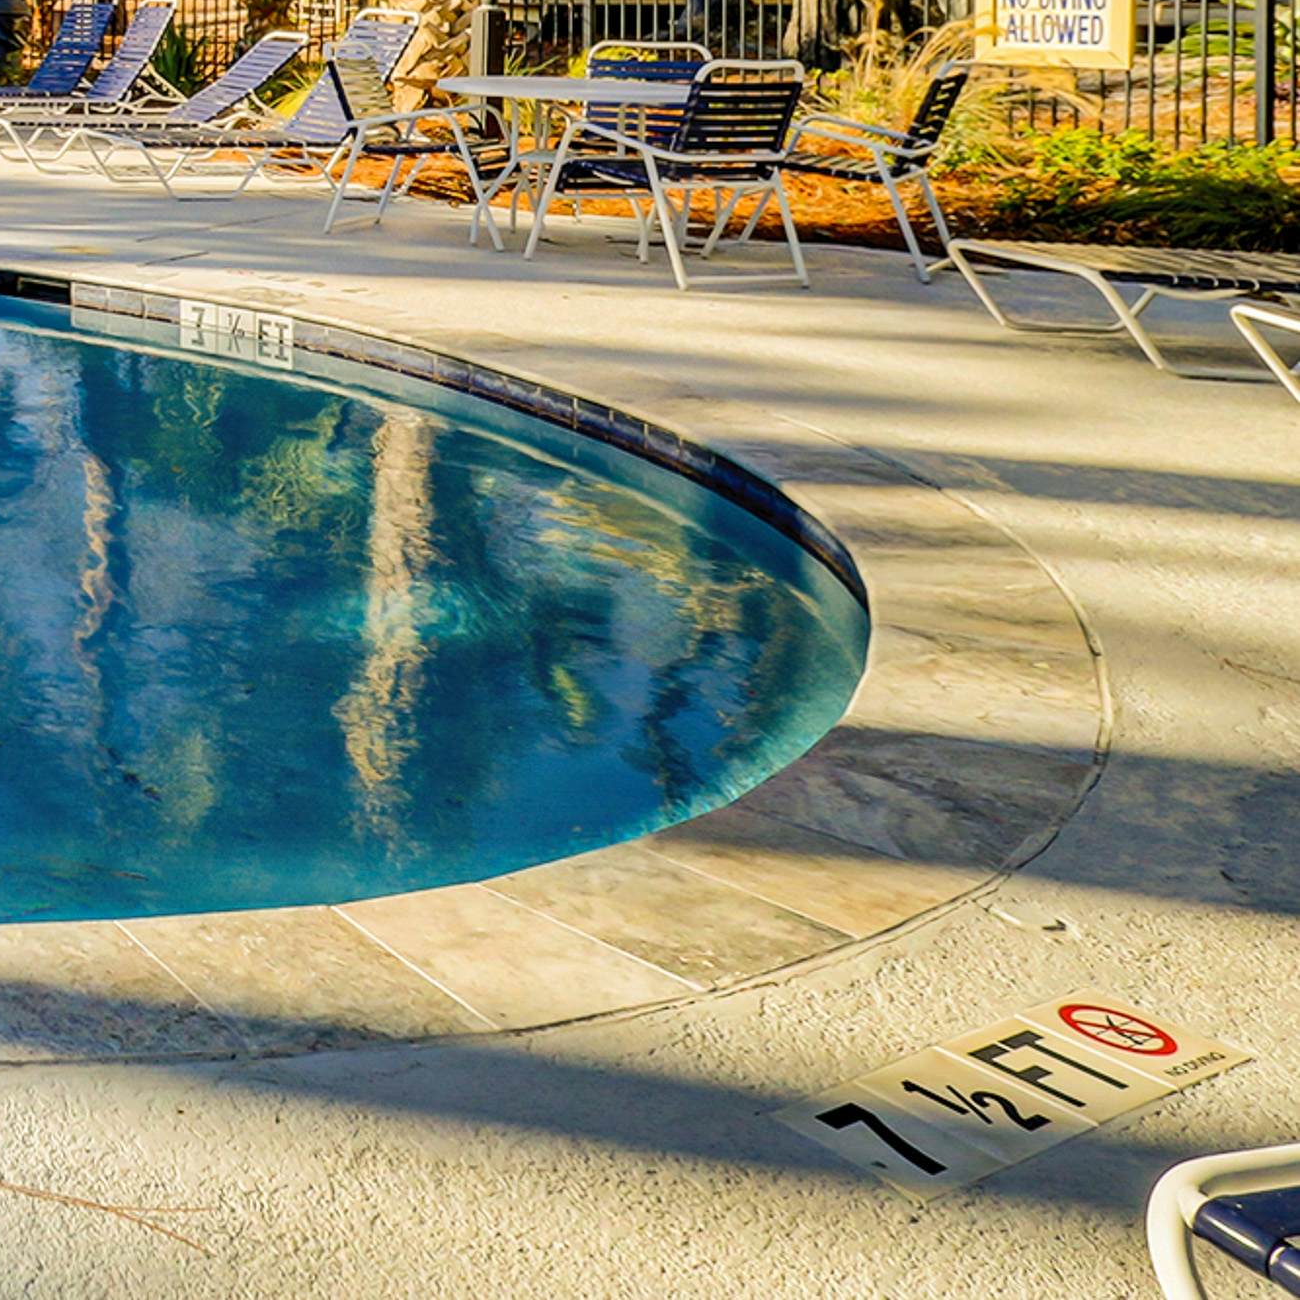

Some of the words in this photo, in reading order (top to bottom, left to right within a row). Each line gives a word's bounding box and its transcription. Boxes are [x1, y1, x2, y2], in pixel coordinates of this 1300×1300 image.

[1004, 14, 1105, 45] ALLOWED
[1182, 1051, 1226, 1071] DIVING
[814, 1102, 948, 1177] 7
[967, 1030, 1130, 1108] FT
